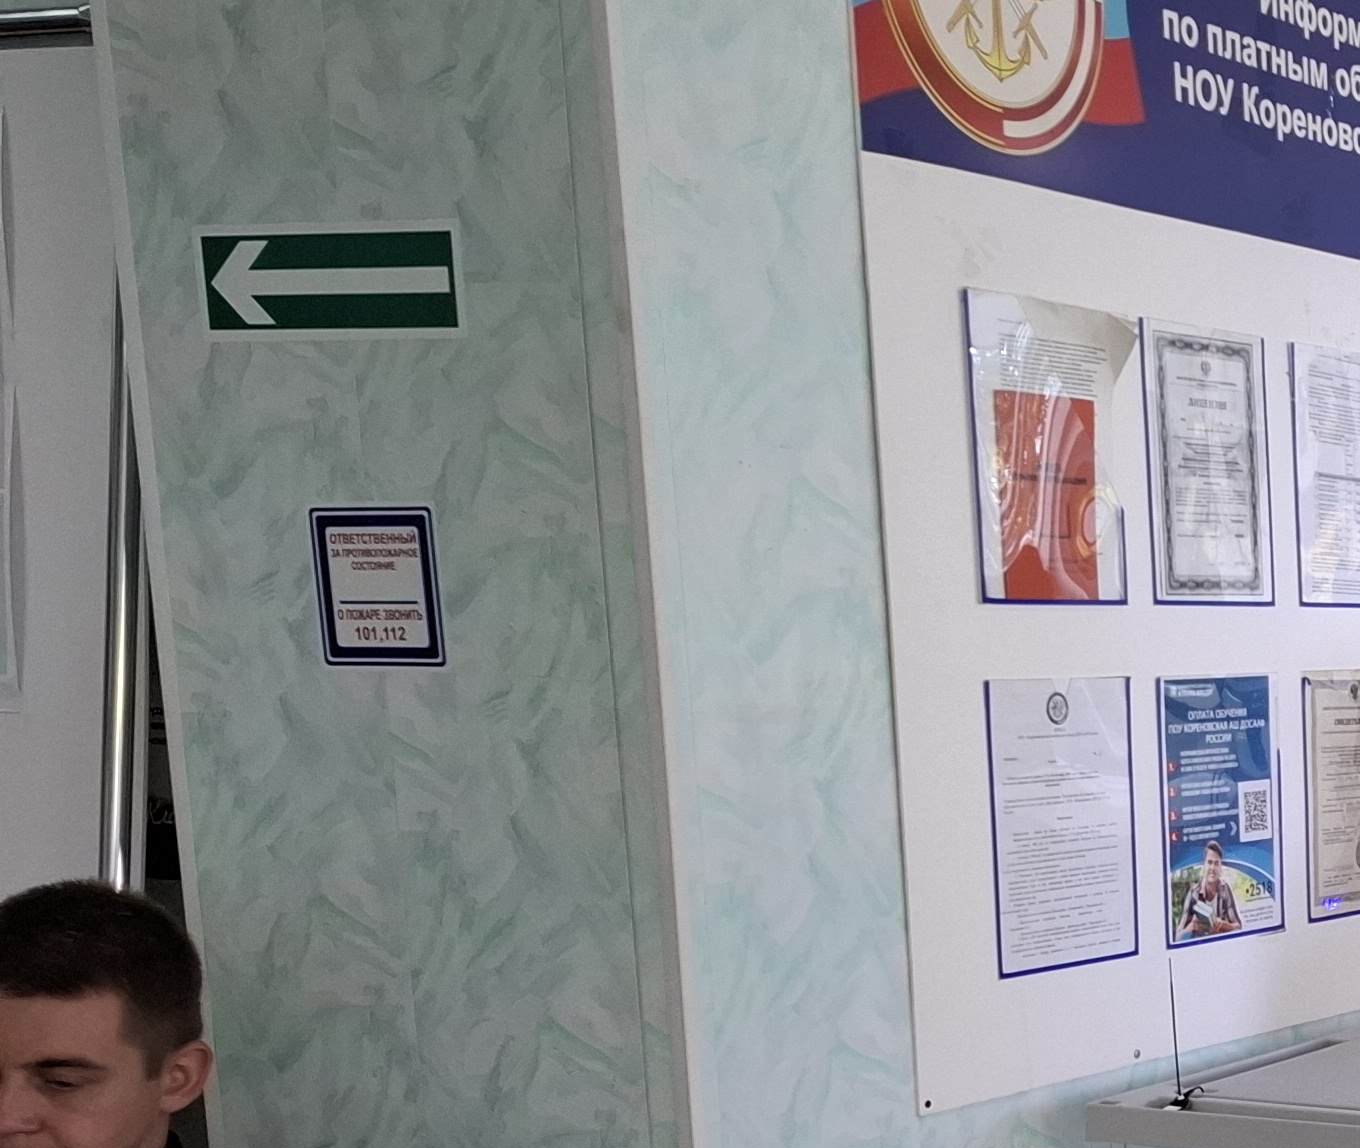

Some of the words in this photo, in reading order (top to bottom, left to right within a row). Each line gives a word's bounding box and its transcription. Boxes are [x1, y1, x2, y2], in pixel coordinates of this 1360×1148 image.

[1162, 9, 1199, 48] по
[1207, 24, 1328, 90] платным
[1173, 61, 1234, 116] НОУ
[330, 530, 417, 545] ОТВЕТСТВЕННЫЙ
[331, 548, 341, 557] ЗА
[342, 548, 418, 558] ПРОТИВОПОЖАРНОЕ
[351, 561, 396, 571] СОСТОЯНИЕ
[338, 610, 344, 620] О
[345, 609, 381, 620] ПОЖАРЕ
[384, 609, 422, 620] ЗВОНИТЬ
